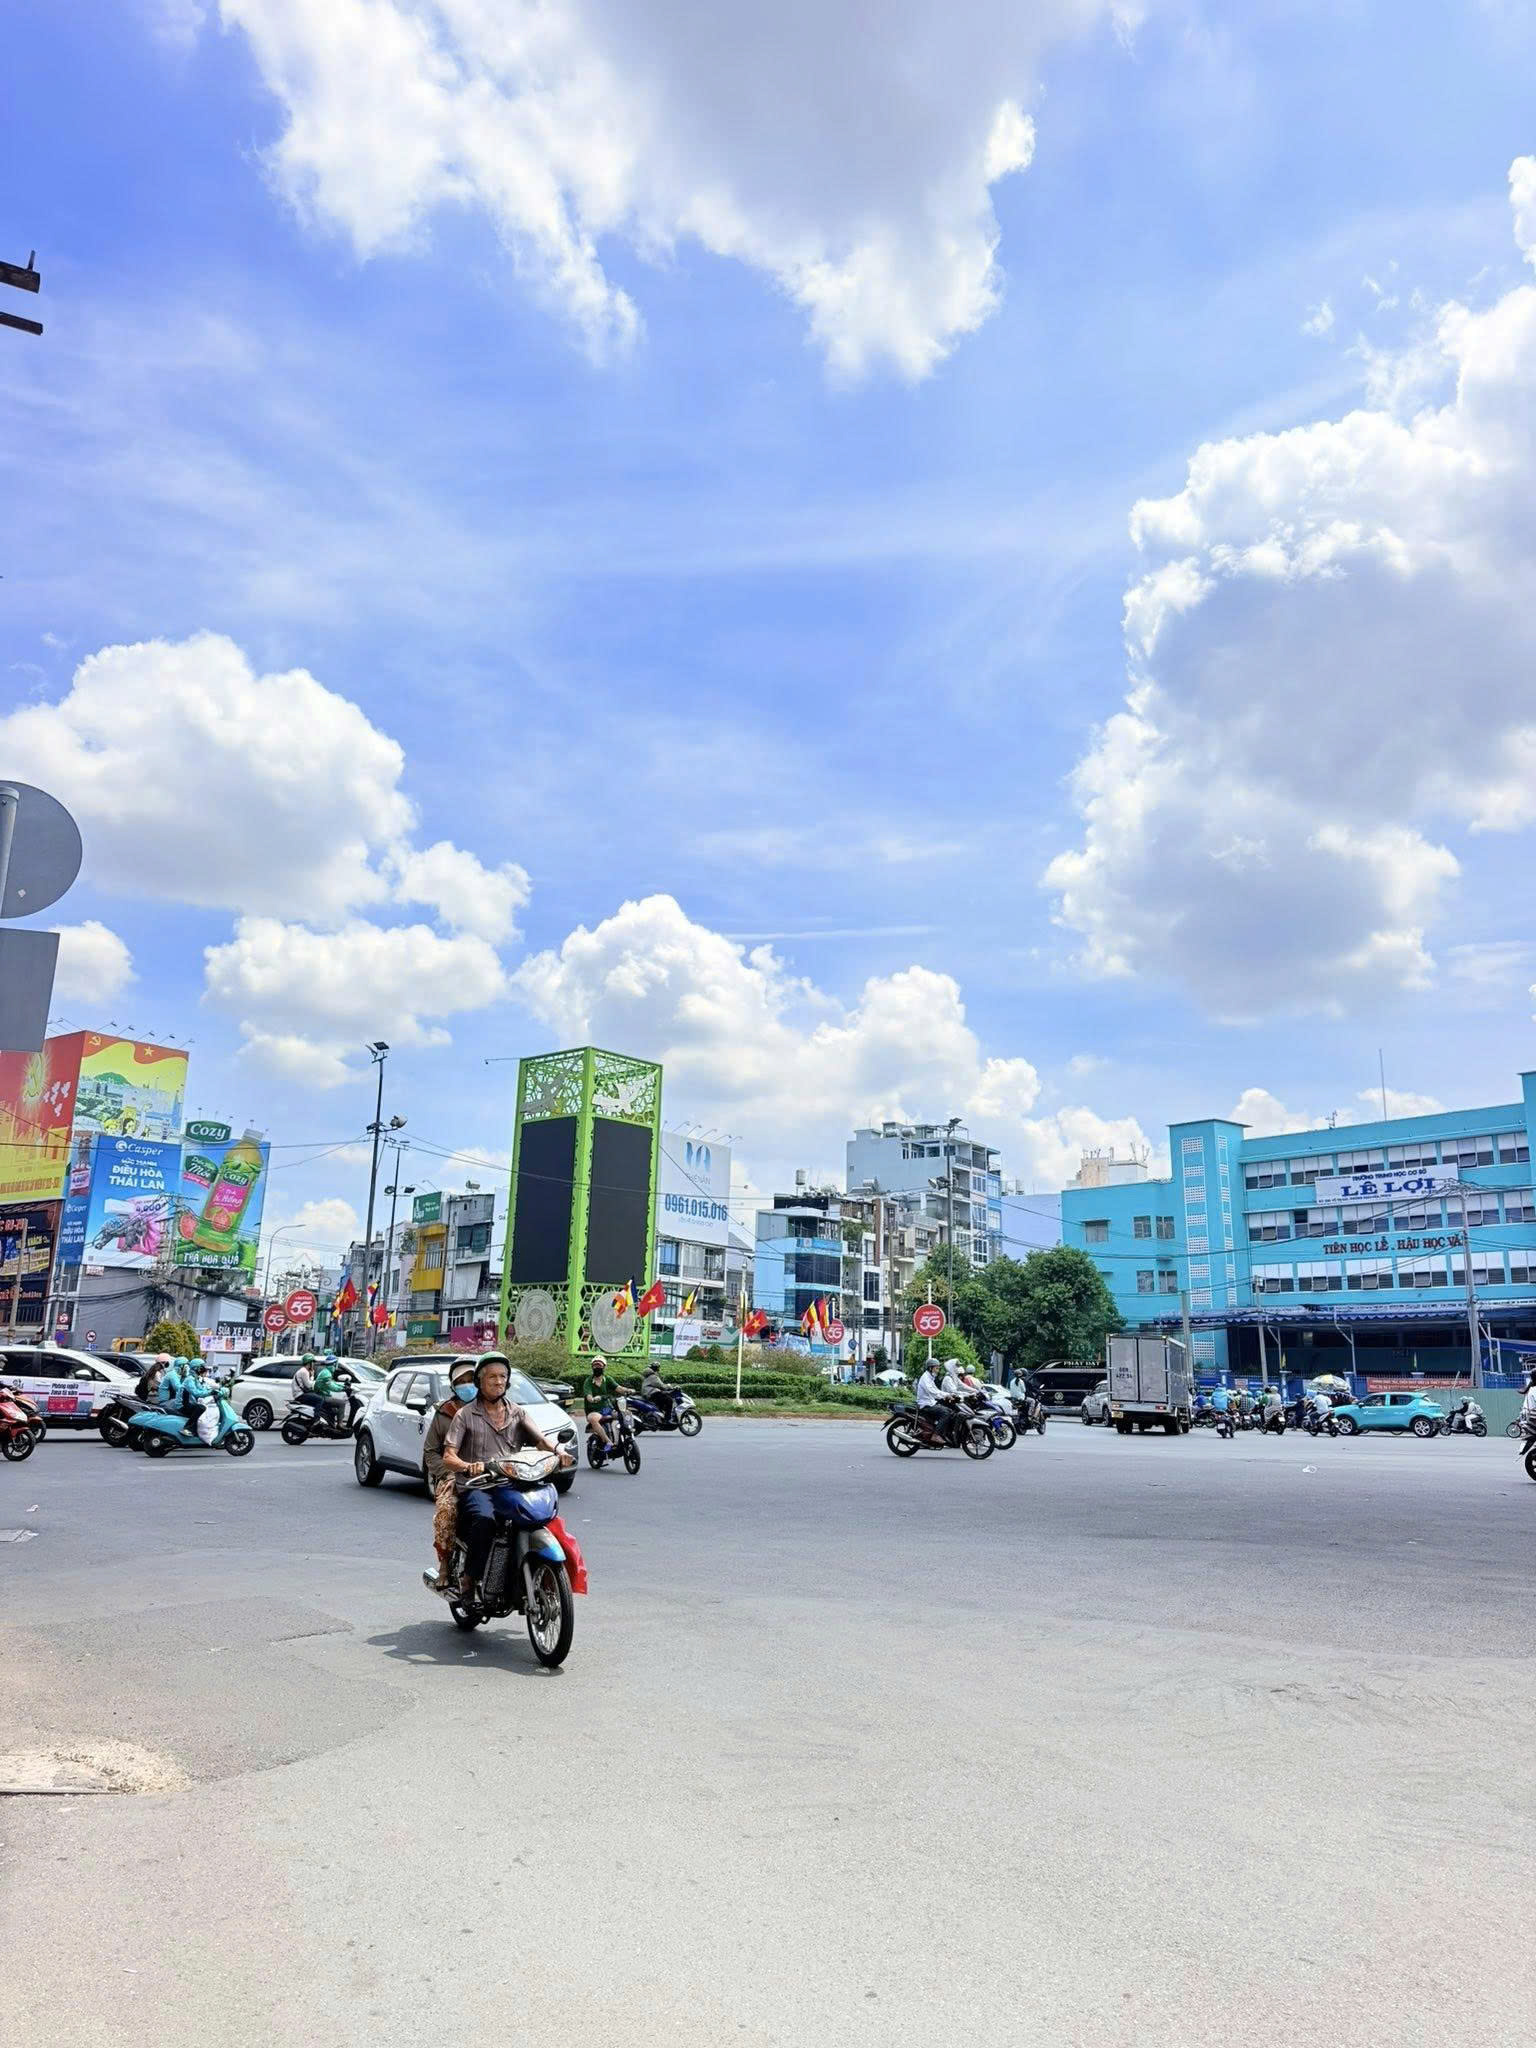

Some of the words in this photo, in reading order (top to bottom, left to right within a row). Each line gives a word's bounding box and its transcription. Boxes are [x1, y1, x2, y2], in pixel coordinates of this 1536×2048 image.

[190, 1123, 227, 1140] Cozy
[128, 1143, 163, 1156] Casper
[139, 1167, 163, 1178] HÒA
[224, 1172, 248, 1186] Cozy
[109, 1175, 138, 1187] THÁI
[140, 1179, 165, 1190] LAN
[1341, 1181, 1378, 1197] LÊ
[1384, 1178, 1436, 1194] LỢI
[665, 1193, 728, 1221] 0961.015.016
[1323, 1241, 1347, 1255] TIÊN
[1350, 1242, 1373, 1255] HỌC
[1397, 1236, 1420, 1251] HẬU
[1423, 1236, 1446, 1250] HỌC
[1446, 1232, 1466, 1248] VĂ
[290, 1301, 312, 1316] 5G
[267, 1314, 285, 1326] 5G
[920, 1316, 940, 1330] 5G
[232, 1327, 242, 1337] XE
